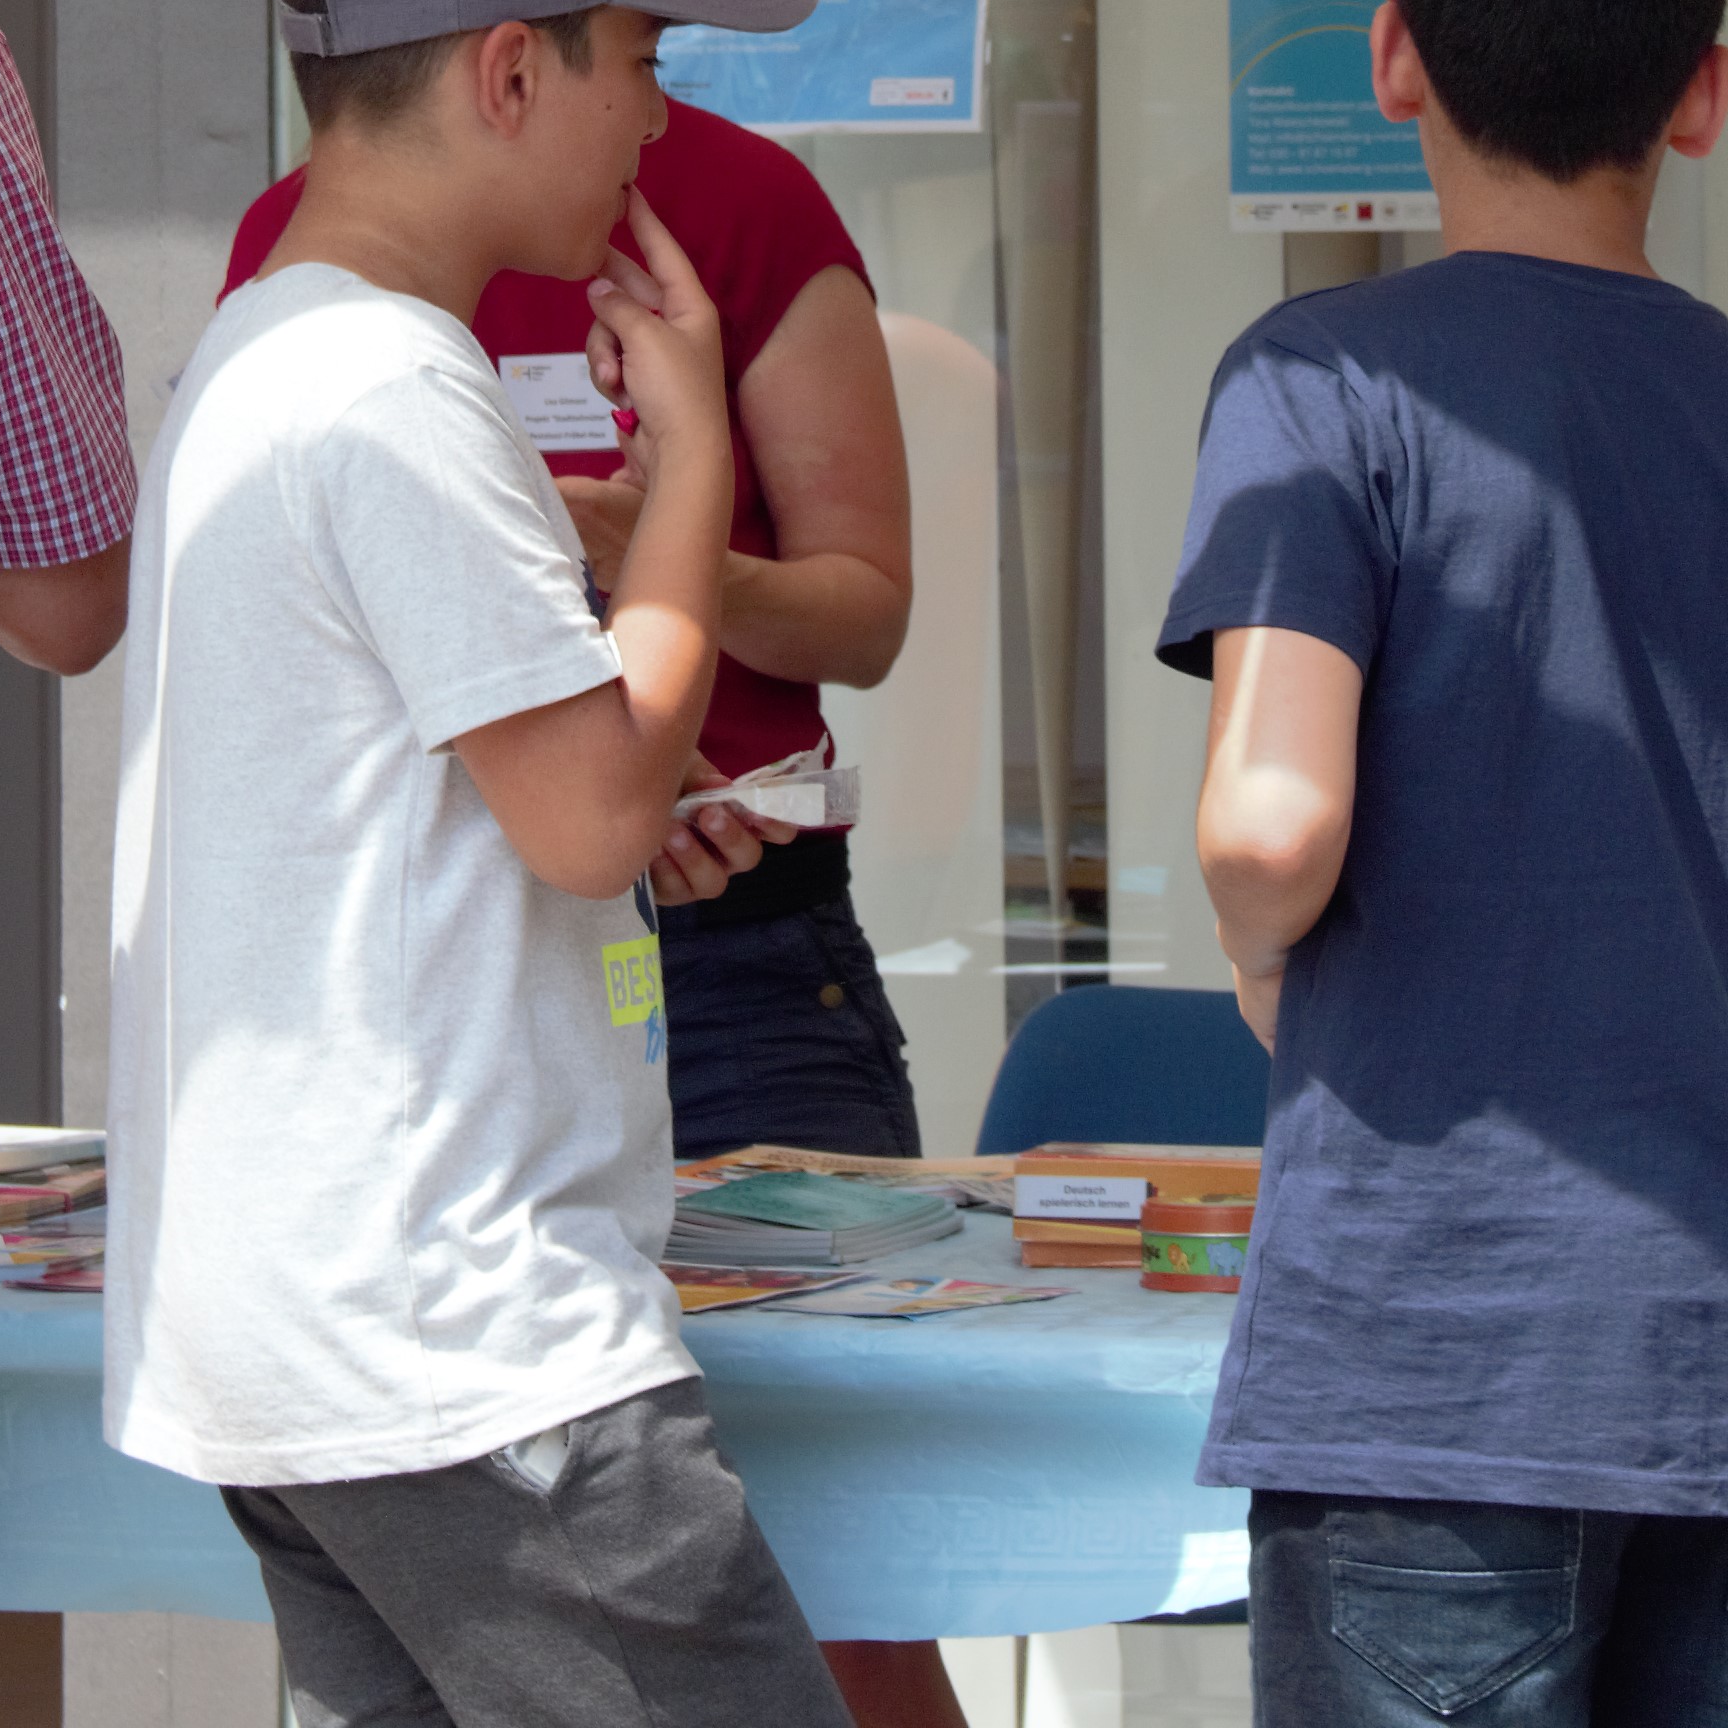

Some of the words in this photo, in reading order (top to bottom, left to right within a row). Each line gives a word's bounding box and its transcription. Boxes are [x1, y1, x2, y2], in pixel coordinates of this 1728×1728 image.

[608, 952, 661, 1010] BES
[1063, 1184, 1107, 1195] Deutsch
[1039, 1198, 1096, 1209] spielerisch
[1098, 1198, 1131, 1209] lernen
